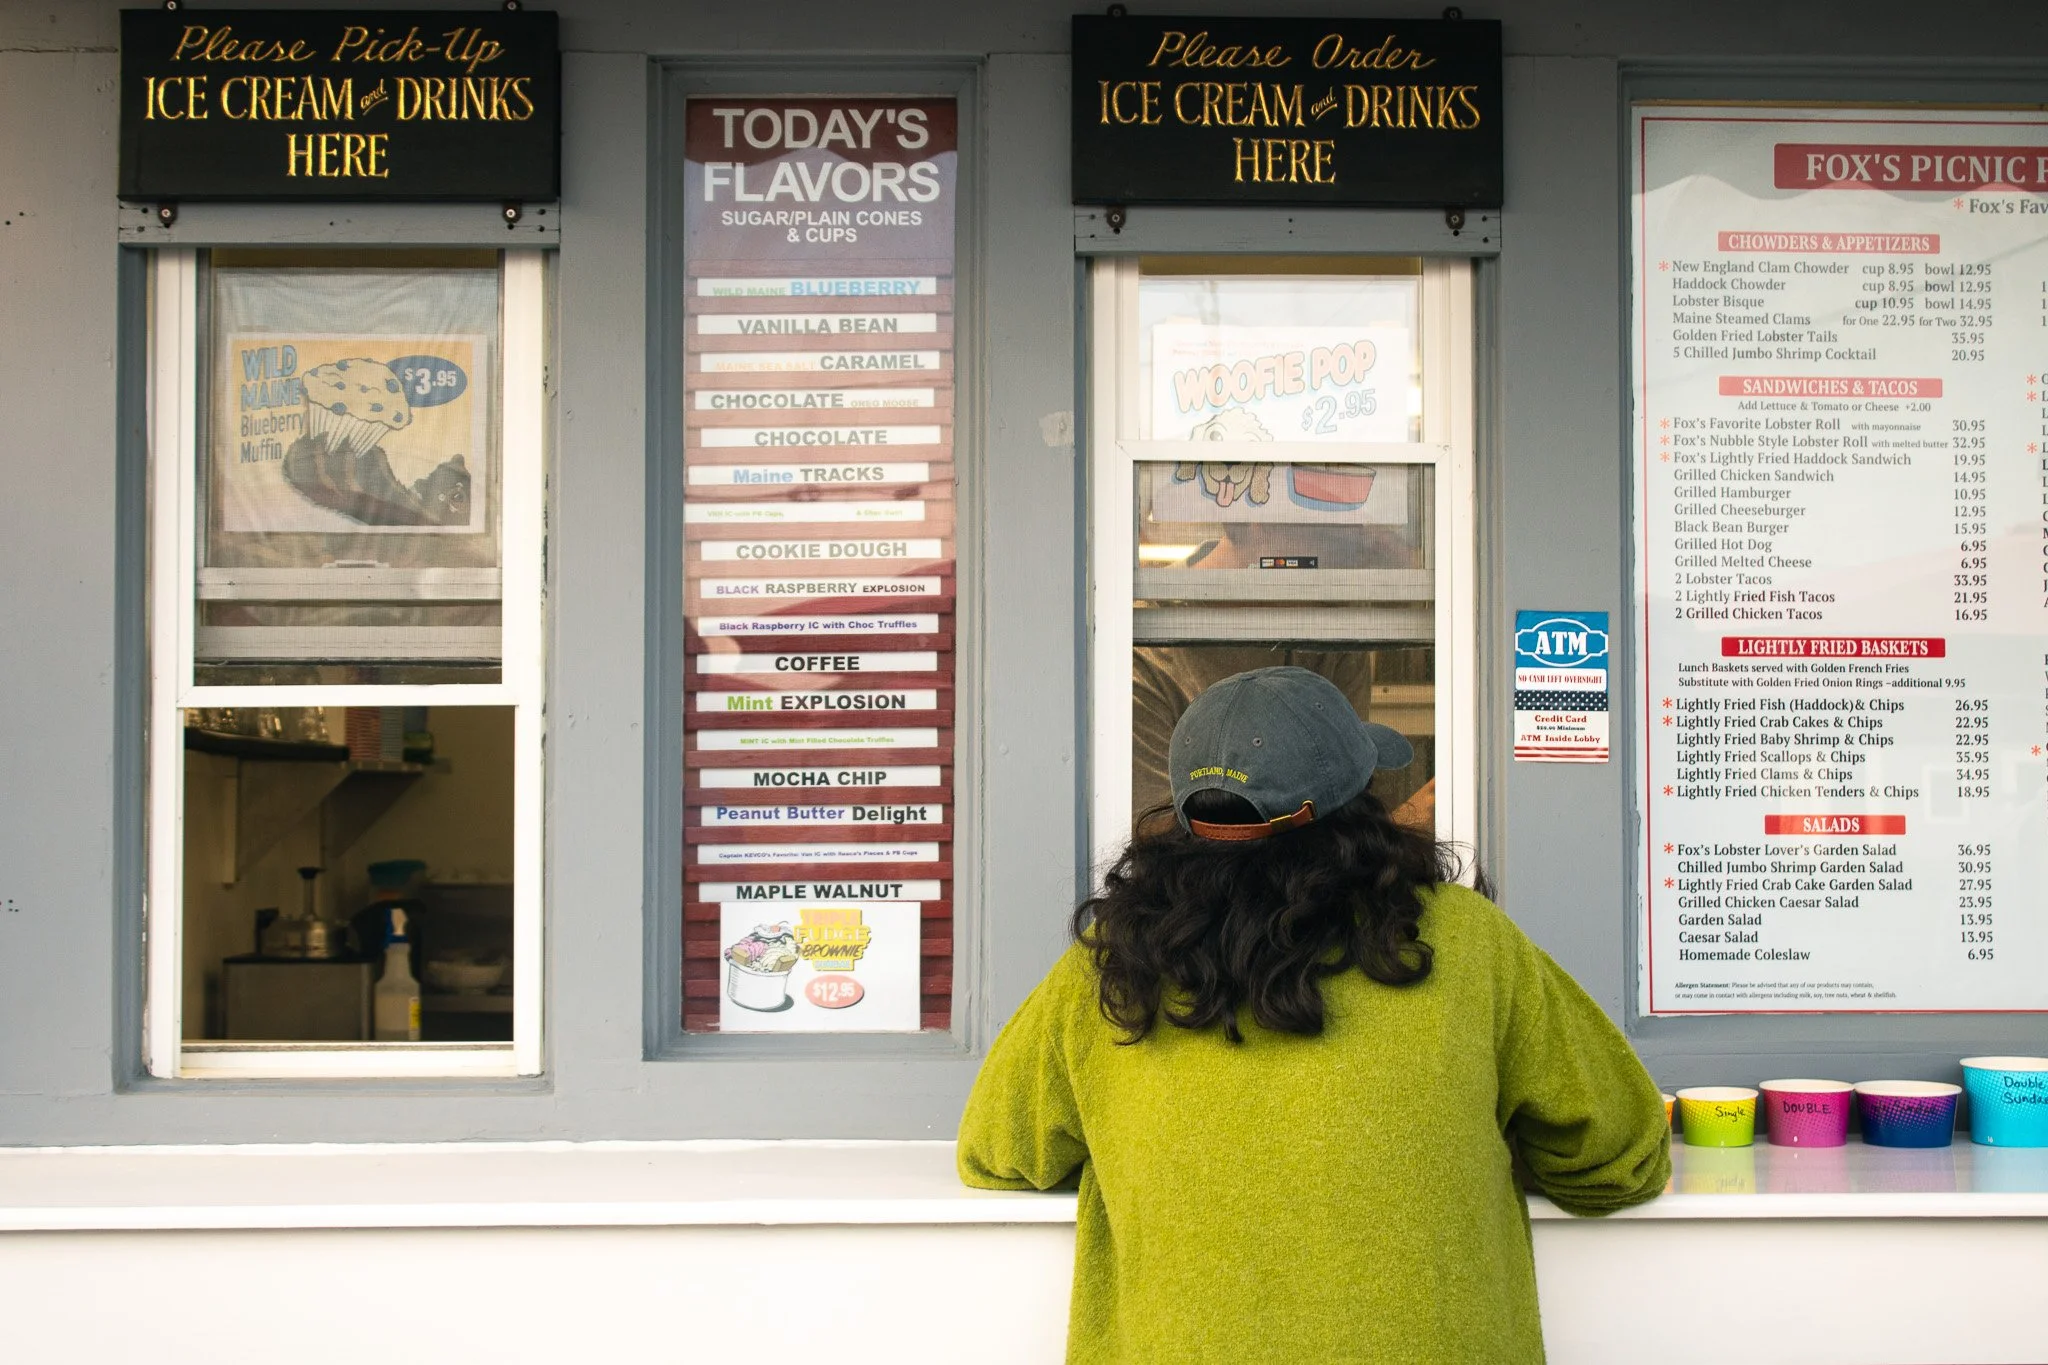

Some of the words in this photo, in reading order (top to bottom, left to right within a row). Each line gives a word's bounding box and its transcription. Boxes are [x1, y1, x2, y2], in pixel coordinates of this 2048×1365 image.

[170, 25, 316, 63] Please
[330, 26, 505, 74] Pick-Up
[1147, 31, 1292, 69] Please
[1311, 33, 1436, 71] Order
[143, 76, 208, 121] ICE
[220, 76, 354, 121] CREAM
[361, 78, 389, 114] and
[393, 76, 535, 121] DRINKS
[1098, 79, 1163, 126] ICE
[1173, 80, 1306, 128] CREAM
[1311, 86, 1338, 118] and
[1343, 84, 1481, 130] DRINKS
[712, 108, 930, 150] TODAY'S
[286, 132, 390, 179] HERE
[1233, 137, 1336, 184] HERE
[1806, 154, 1900, 184] FOX'S
[1911, 155, 2025, 184] PICNIC
[704, 161, 940, 203] FLAVORS
[1970, 199, 2014, 214] Fox's
[722, 211, 850, 226] SUGAR/PLAIN
[856, 211, 922, 226] CONES
[787, 228, 800, 243] &
[806, 228, 857, 243] CUPS
[1726, 234, 1818, 252] CHOWDERS
[1822, 236, 1833, 250] &
[1836, 234, 1931, 252] APPETIZERS
[1673, 261, 1699, 272] New
[1703, 261, 1754, 275] England
[1758, 261, 1790, 273] Clam
[1794, 261, 1849, 274] Chowder
[1863, 266, 1885, 277] cup
[1888, 263, 1913, 275] 8.95
[1925, 263, 1955, 276] bowl
[1959, 264, 1991, 275] 12.95
[790, 280, 921, 297] BLUEBERRY
[737, 318, 832, 334] VANILLA
[839, 317, 898, 333] BEAN
[1673, 312, 1712, 324] Maine
[1716, 313, 1769, 324] Steamed
[1773, 313, 1811, 325] Clams
[1843, 315, 1856, 325] for
[1859, 316, 1879, 325] One
[1882, 314, 1915, 326] 22.95
[1919, 316, 1933, 326] for
[1935, 317, 1957, 327] Two
[1960, 315, 1992, 327] 32.95
[241, 345, 298, 382] WILD
[820, 354, 926, 370] CARAMEL
[404, 368, 457, 395] $3.95
[1174, 351, 1305, 413] WOOFIE
[1311, 340, 1377, 391] POP
[240, 377, 301, 412] MAINE
[1741, 378, 1850, 396] SANDWICHES
[1852, 378, 1864, 395] &
[1868, 378, 1921, 396] TACOS
[711, 393, 844, 409] CHOCOLATE
[1301, 388, 1377, 435] $2.95
[240, 411, 304, 438] Blueberry
[754, 430, 888, 446] CHOCOLATE
[1674, 435, 1706, 446] Fox's
[1710, 434, 1754, 446] Nubble
[1758, 435, 1788, 450] Style
[1792, 435, 1839, 447] Lobster
[1843, 436, 1867, 447] Roll
[1893, 440, 1920, 448] melted
[1923, 440, 1948, 448] butter
[1953, 437, 1985, 448] 32.95
[240, 438, 282, 464] Muffin
[733, 469, 793, 483] Maine
[800, 467, 884, 482] TRACKS
[736, 544, 820, 559] COOKIE
[828, 542, 907, 558] DOUGH
[1675, 573, 1681, 584] 2
[1687, 572, 1732, 584] Lobster
[1736, 573, 1772, 584] Tacos
[1954, 574, 1986, 586] 33.95
[717, 585, 759, 594] BLACK
[766, 583, 857, 594] RASPBERRY
[863, 584, 926, 593] EXPLOSION
[752, 622, 805, 631] Raspberry
[809, 621, 819, 629] IC
[1535, 631, 1588, 655] ATM
[1738, 640, 1807, 655] LIGHTLY
[1810, 640, 1857, 655] FRIED
[1861, 640, 1928, 655] BASKETS
[775, 656, 859, 672] COFFEE
[1529, 675, 1545, 683] CASH
[1547, 675, 1562, 683] LEFT
[1564, 675, 1602, 684] OVERNIGHT
[727, 697, 773, 710] Mint
[781, 695, 906, 711] EXPLOSION
[1535, 714, 1563, 722] Credit
[1574, 735, 1600, 743] Lobby
[1677, 750, 1720, 765] Lightly
[1725, 750, 1756, 762] Fried
[1761, 751, 1811, 765] Scallops
[1817, 751, 1825, 762] &
[1831, 751, 1865, 765] Chips
[1957, 751, 1989, 763] 35.95
[754, 772, 830, 787] MOCHA
[838, 771, 887, 786] CHIP
[1226, 768, 1249, 784] MAINE
[717, 806, 780, 820] Peanut
[787, 806, 845, 820] Butter
[852, 806, 927, 825] Delight
[1804, 817, 1860, 833] SALADS
[736, 886, 806, 899] MAPLE
[814, 884, 903, 898] WALNUT
[1679, 914, 1724, 925] Garden
[1728, 914, 1761, 925] Salad
[1961, 914, 1992, 925] 13.95
[797, 927, 868, 942] FUDGE
[802, 943, 863, 958] BROWNIE
[1680, 949, 1750, 960] Homemade
[1755, 948, 1810, 960] Coleslaw
[1968, 949, 1993, 960] 6.95
[813, 981, 855, 1002] $12.95
[2003, 1076, 2046, 1090] Double
[1715, 1106, 1746, 1122] Single
[1783, 1102, 1831, 1114] DOUBLE
